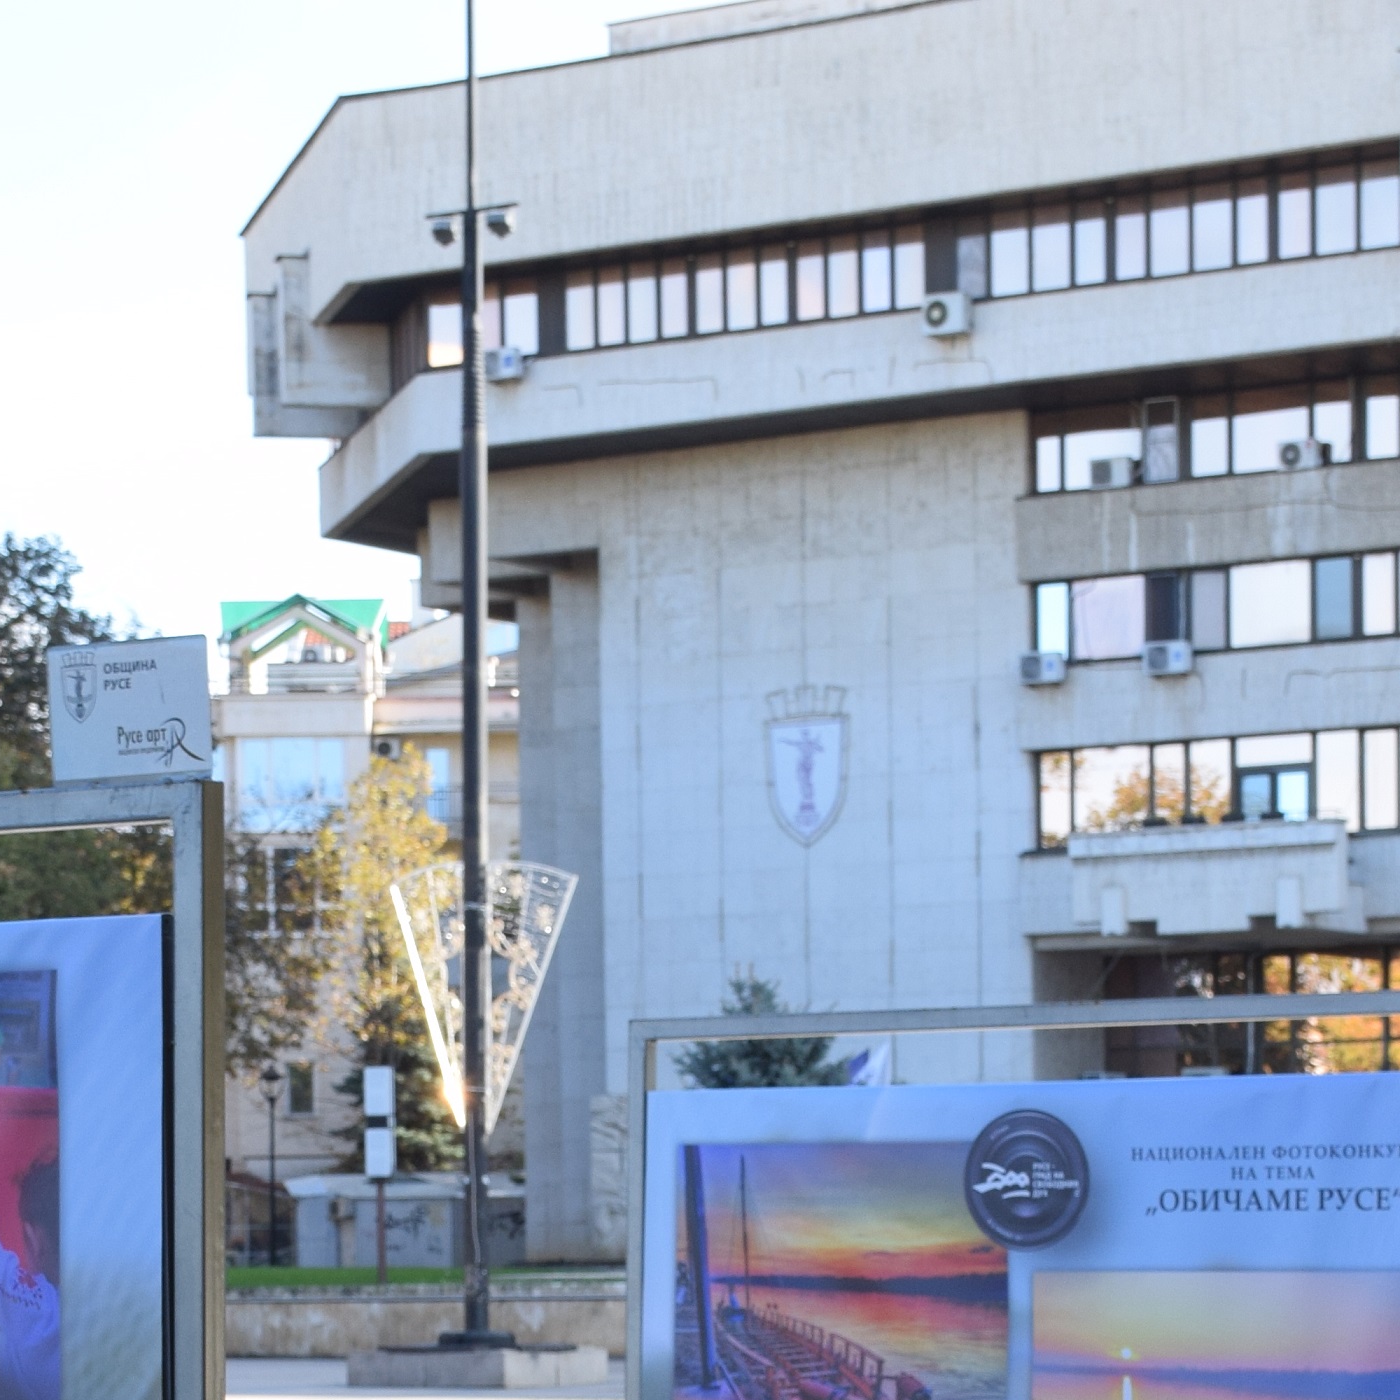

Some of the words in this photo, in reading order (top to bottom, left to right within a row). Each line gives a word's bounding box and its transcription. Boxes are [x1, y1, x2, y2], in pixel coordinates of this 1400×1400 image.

[103, 659, 157, 675] ОБЩИНА
[103, 678, 132, 691] РУСЕ
[117, 726, 143, 749] Русе
[1131, 1146, 1265, 1163] НАЦИОНАЛЕН
[1231, 1167, 1257, 1180] НА
[1265, 1166, 1315, 1180] ТЕМА
[1145, 1189, 1308, 1216] „ОБИЧАМЕ
